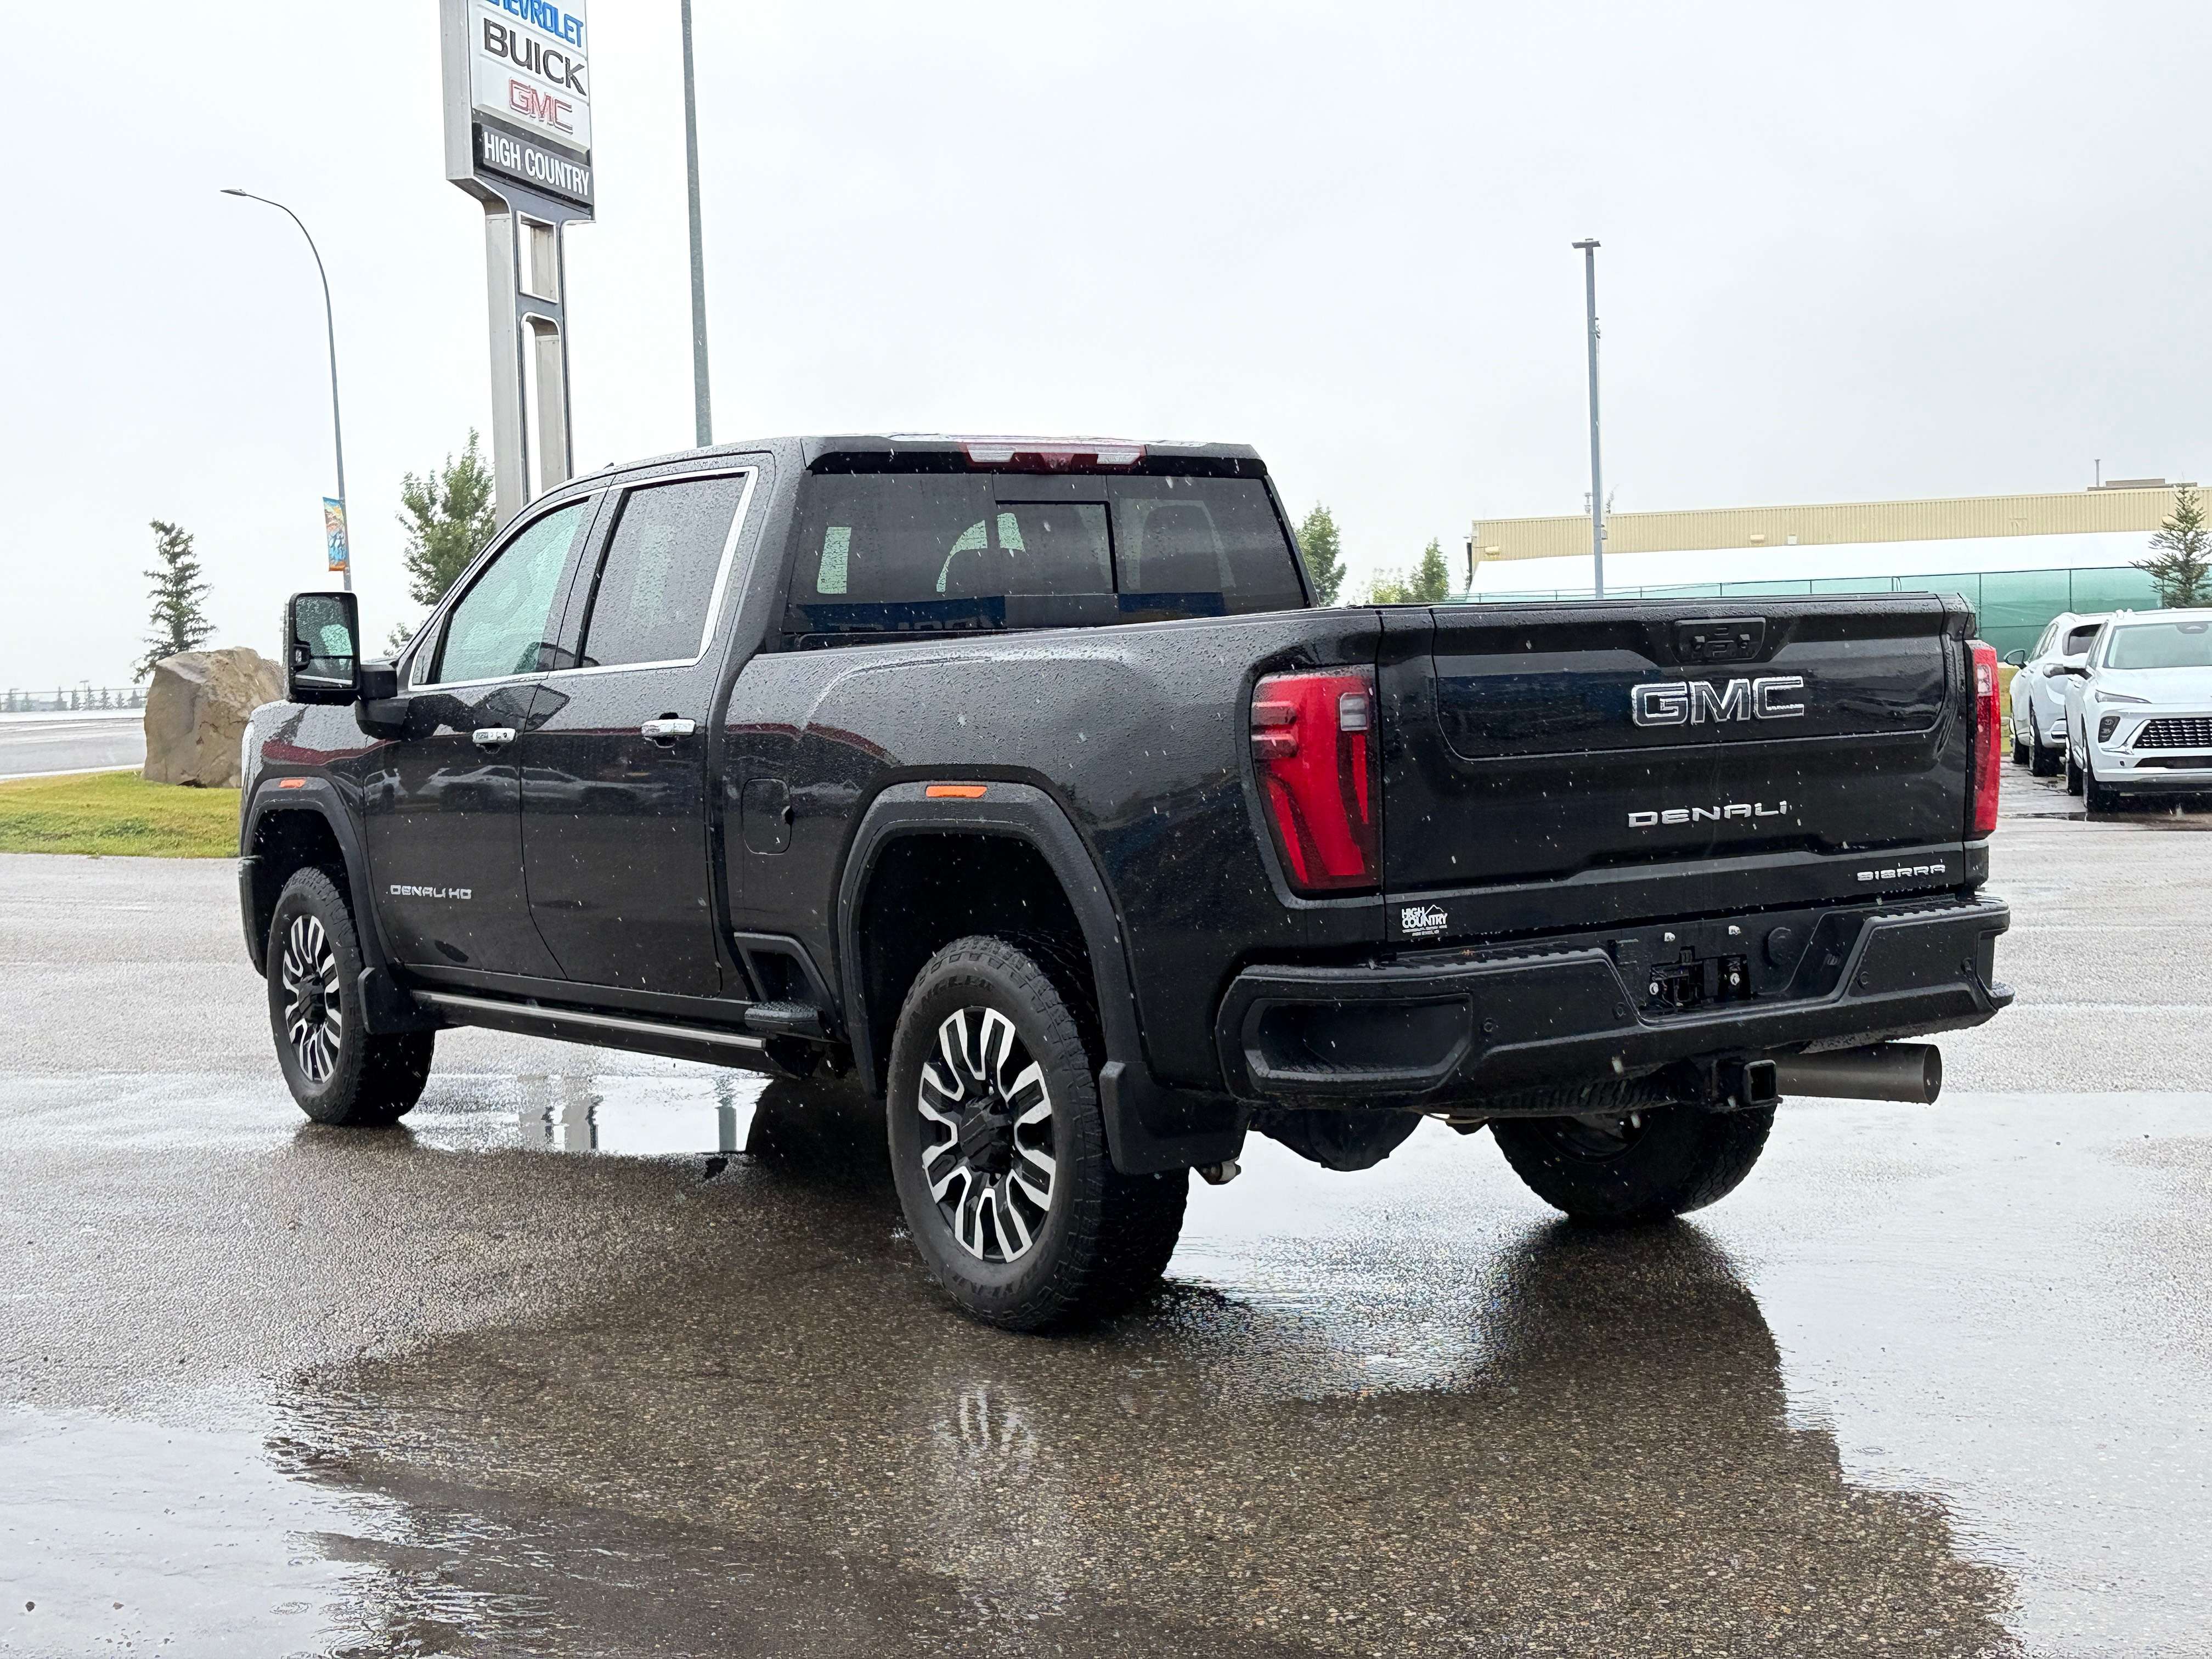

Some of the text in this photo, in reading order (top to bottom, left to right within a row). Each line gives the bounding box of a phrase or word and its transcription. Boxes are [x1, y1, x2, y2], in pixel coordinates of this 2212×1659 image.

[486, 0, 584, 48] EVROLET
[483, 18, 587, 97] BUICK
[509, 78, 573, 135] GMC
[484, 131, 590, 196] HIGH COUNTRY
[1632, 675, 1804, 727] GMC
[1628, 800, 1787, 827] DENALI
[1857, 865, 1945, 881] SIERRA
[390, 884, 472, 900] DENALI HD
[1402, 906, 1425, 919] HIGH
[1402, 913, 1448, 928] COUNTRY
